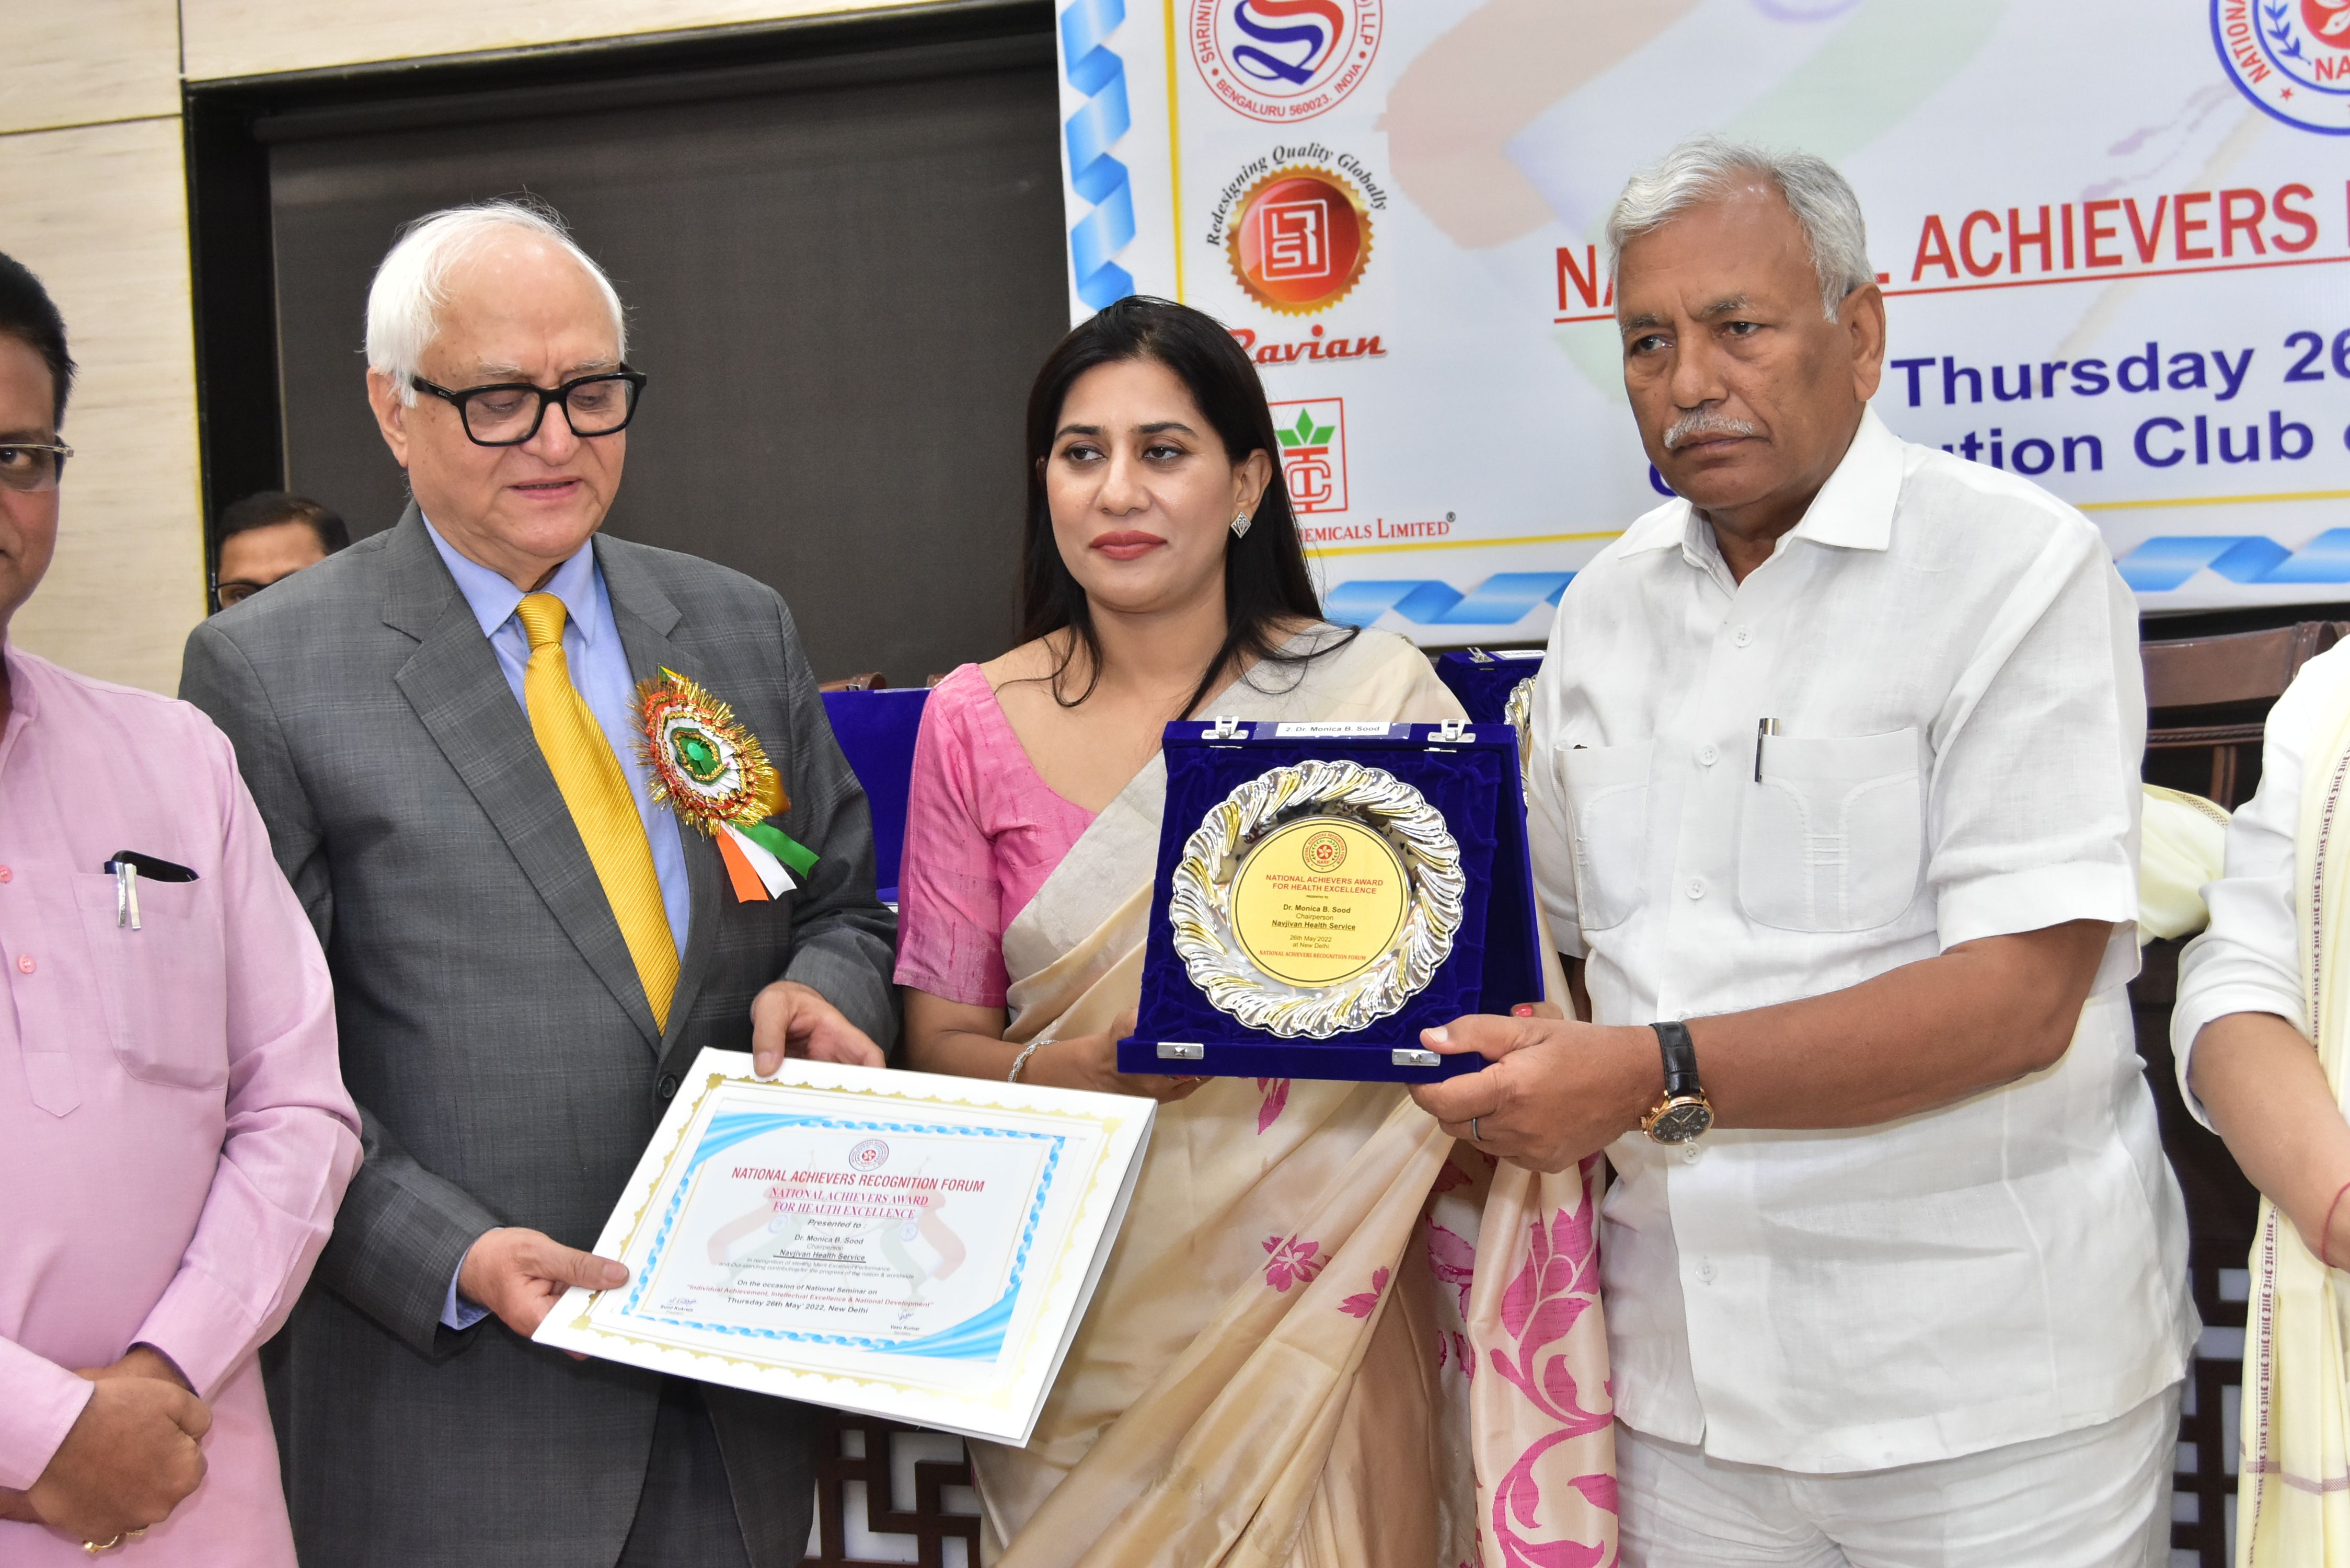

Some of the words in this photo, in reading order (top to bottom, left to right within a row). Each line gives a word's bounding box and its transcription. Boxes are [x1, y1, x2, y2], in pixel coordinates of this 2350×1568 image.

[1196, 0, 1215, 63] SHRINI
[1360, 13, 1376, 45] LLP
[1216, 79, 1286, 117] BENGALURU
[1334, 63, 1362, 94] INDIA
[1206, 157, 1269, 246] Redesigning
[1272, 142, 1334, 165] Quality
[1337, 153, 1388, 211] Globally
[1910, 182, 2319, 283] ACHIEVERS
[1890, 341, 2255, 407] Thursday
[2133, 410, 2314, 468] Club
[1307, 876, 1352, 884] ACHIEVERS
[1324, 886, 1377, 894] EXCELLENCE
[1272, 919, 1302, 928] Navjivan
[732, 1167, 787, 1182] NATIONAL
[790, 1171, 856, 1185] ACHIEVERS
[858, 1174, 938, 1190] RECOGNITION
[940, 1179, 985, 1192] FORUM
[770, 1187, 824, 1200] NATIONAL
[825, 1192, 888, 1204] ACHIEVERS
[889, 1195, 929, 1206] AWARD
[773, 1201, 795, 1212] FOR
[797, 1203, 841, 1215] HEALTH
[843, 1206, 916, 1219] EXCELLENCE
[808, 1219, 851, 1228] Presented
[779, 1249, 811, 1258] Navjivan
[807, 1243, 844, 1251] Chairperson
[728, 1297, 764, 1307] Thursday
